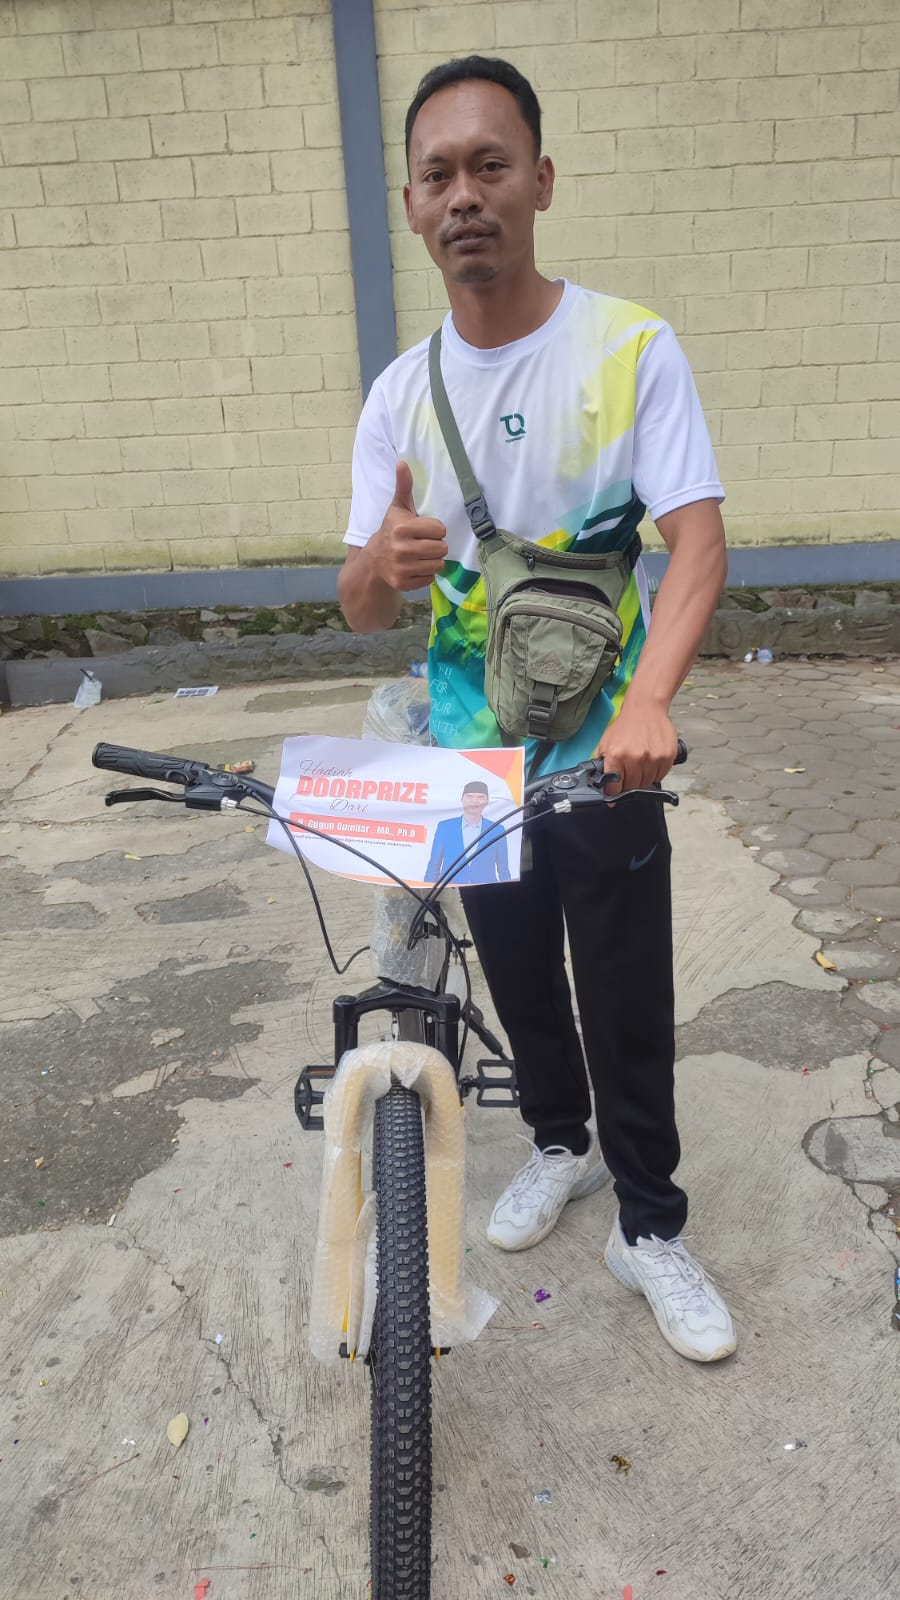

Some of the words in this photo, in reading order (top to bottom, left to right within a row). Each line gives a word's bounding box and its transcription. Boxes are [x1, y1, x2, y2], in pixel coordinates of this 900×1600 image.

[429, 679, 448, 695] FOR
[300, 759, 353, 777] Hadiah
[296, 774, 430, 805] DOORPRIZE
[329, 798, 369, 813] Dari
[307, 818, 335, 831] Gugun
[337, 821, 369, 834] Gumilar
[397, 827, 417, 839] Ph.D
